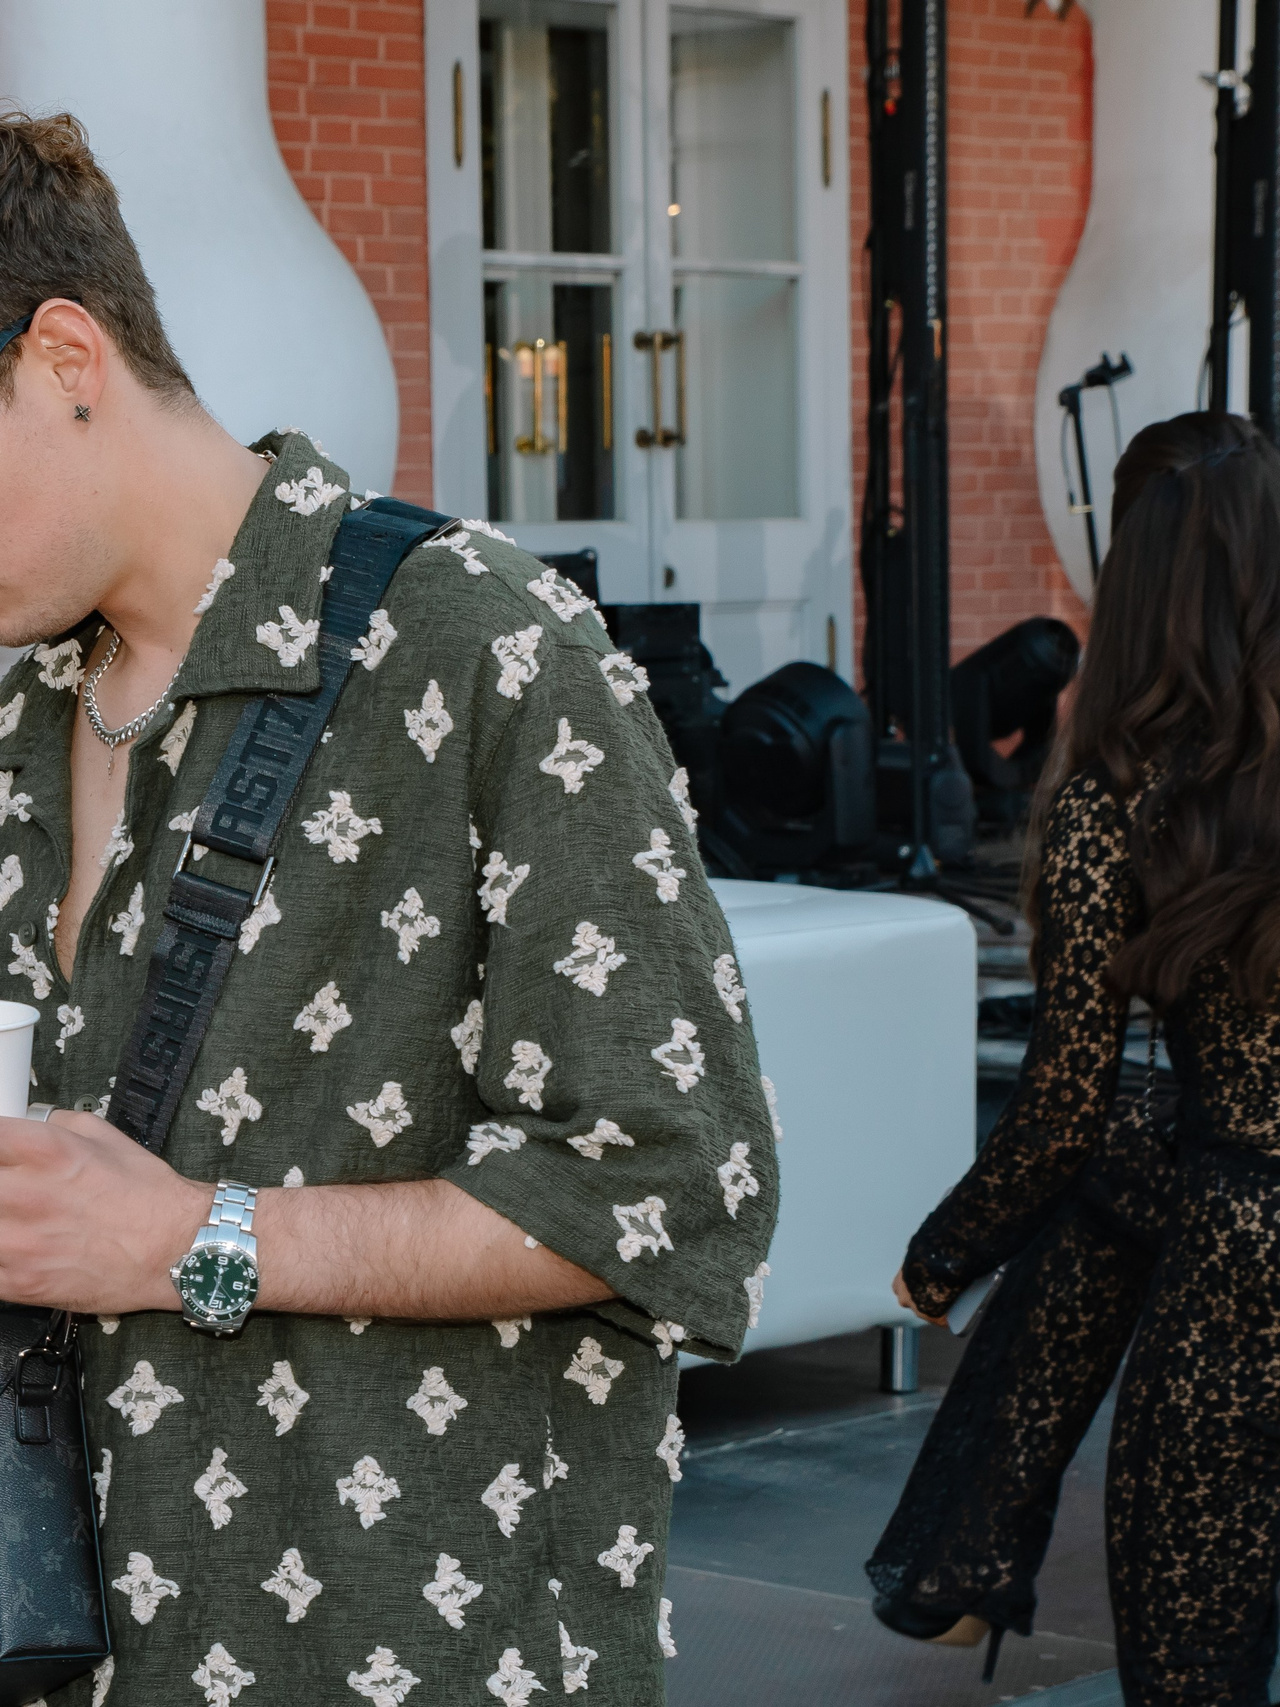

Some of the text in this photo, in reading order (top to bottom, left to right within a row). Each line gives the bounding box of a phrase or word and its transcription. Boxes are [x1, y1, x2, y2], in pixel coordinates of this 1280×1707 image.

[185, 1255, 197, 1268] 20
[247, 1266, 256, 1280] 40
[181, 1289, 190, 1300] 10
[210, 1299, 223, 1309] 12
[239, 1300, 252, 1312] 50
